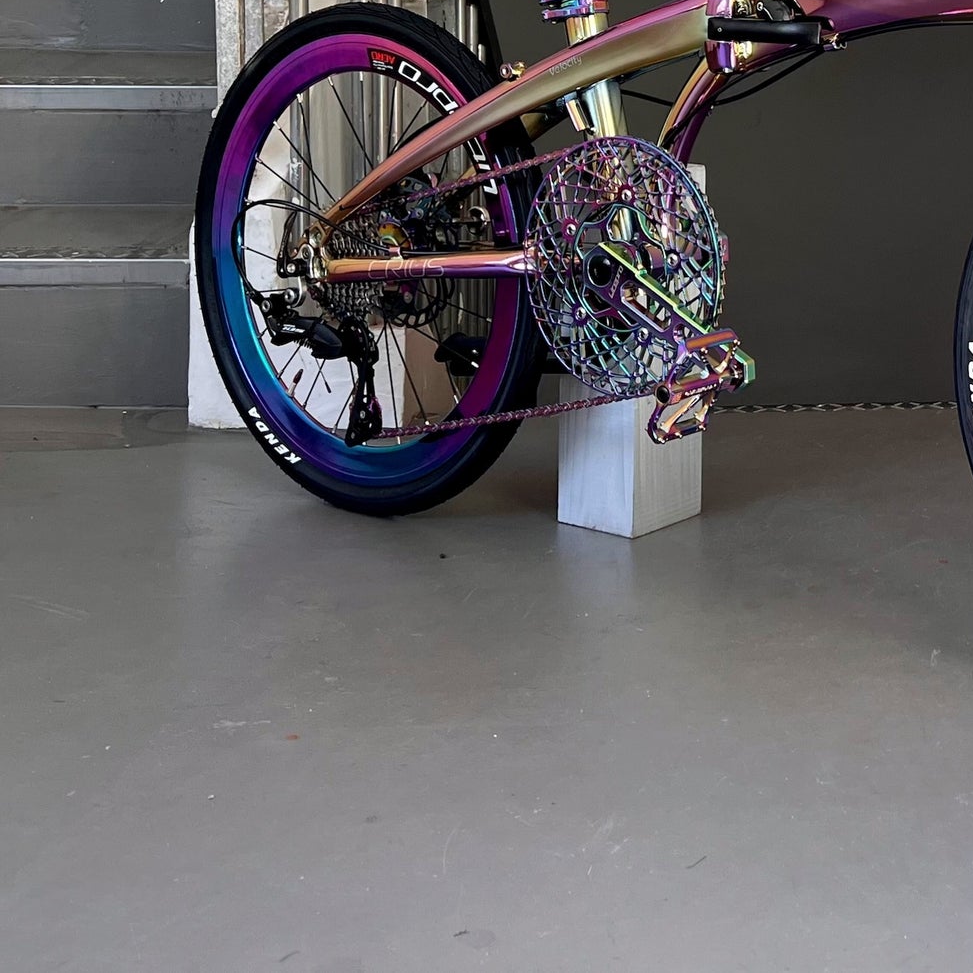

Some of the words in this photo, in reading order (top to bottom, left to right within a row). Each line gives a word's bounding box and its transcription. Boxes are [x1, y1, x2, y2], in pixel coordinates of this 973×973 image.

[549, 56, 582, 76] Velocity
[398, 60, 499, 195] Litpro
[368, 258, 445, 279] CRIUS
[247, 405, 302, 465] KENDA
